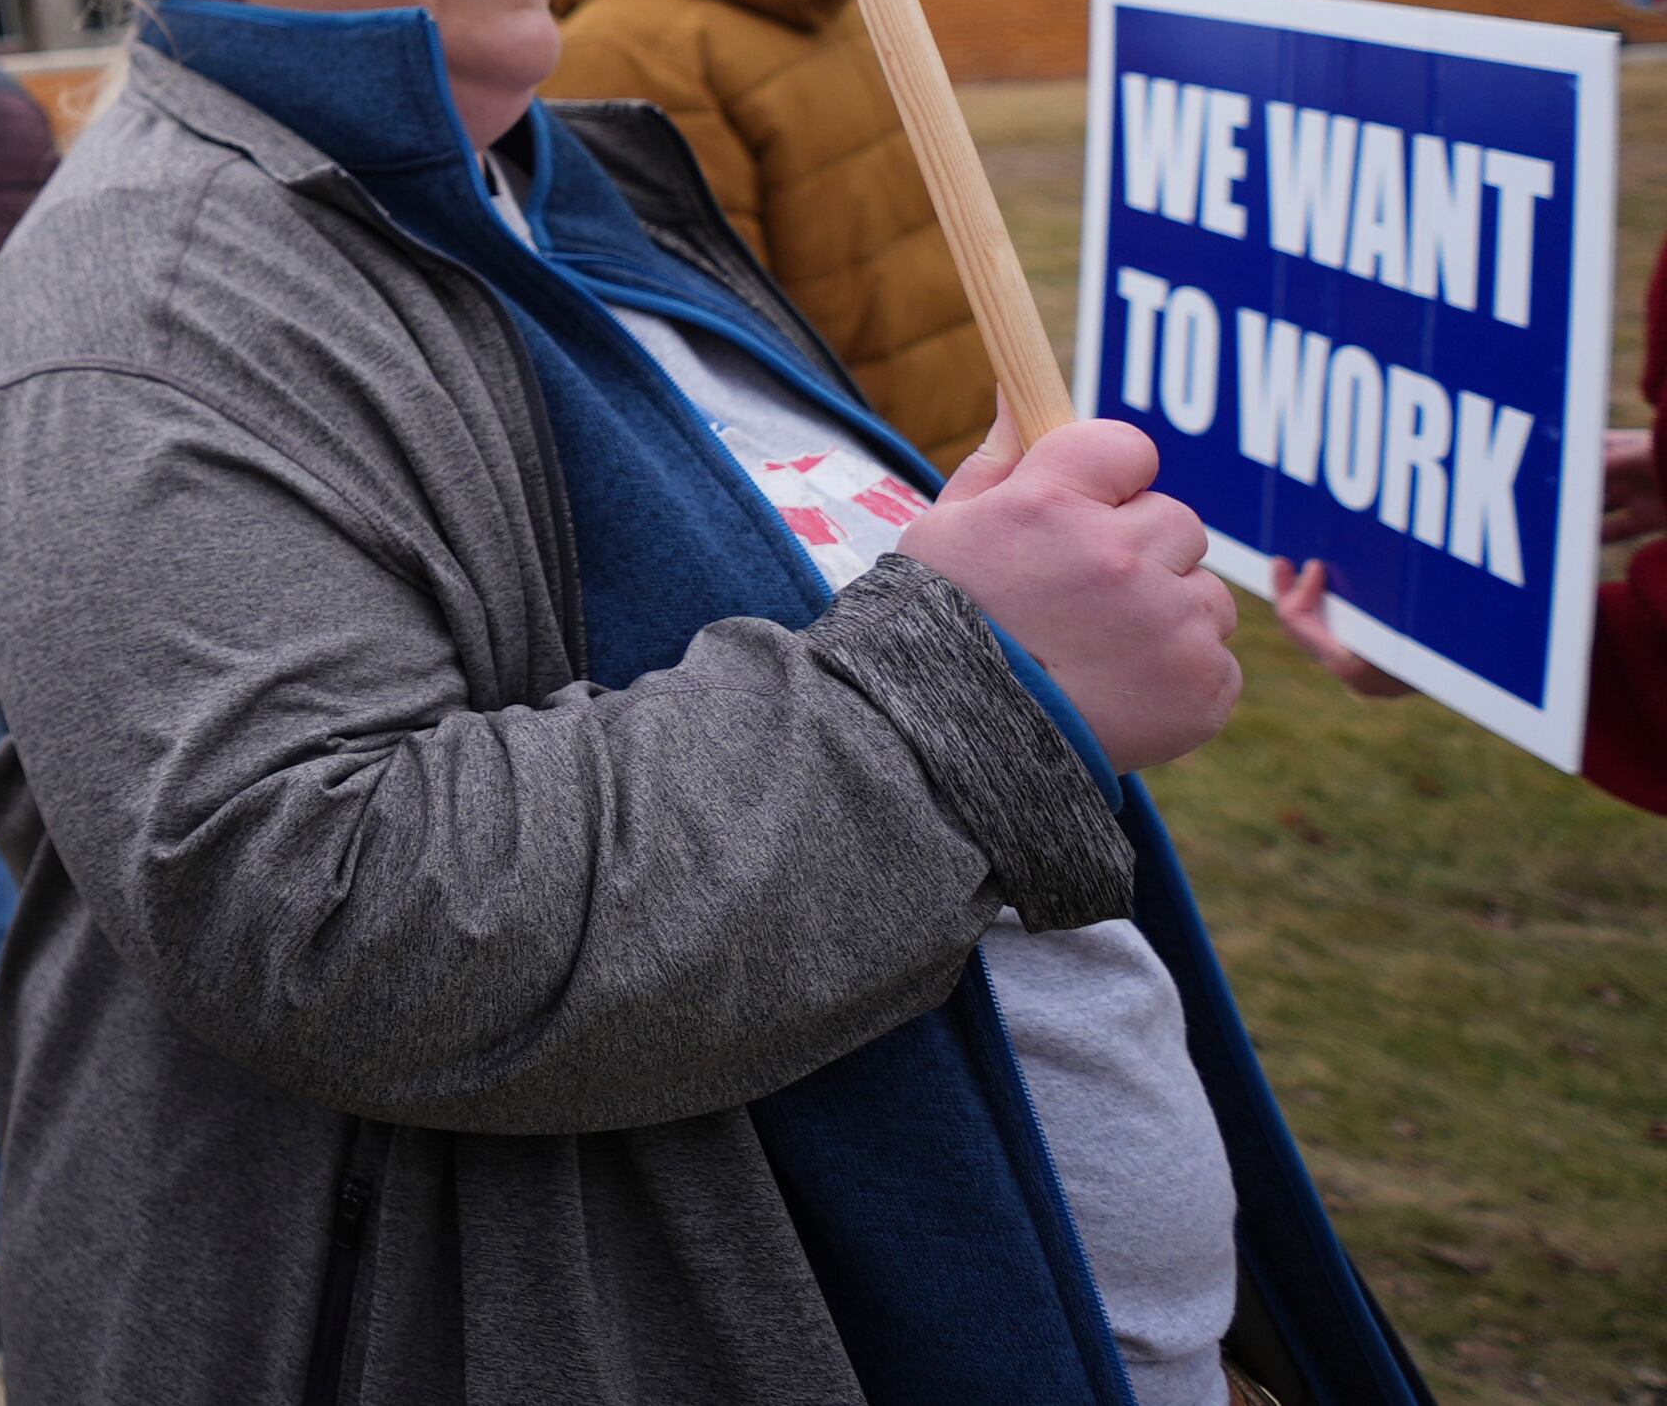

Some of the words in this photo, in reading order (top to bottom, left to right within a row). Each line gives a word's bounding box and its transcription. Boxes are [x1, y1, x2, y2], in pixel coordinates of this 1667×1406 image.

[1121, 72, 1249, 239] WE
[1266, 100, 1554, 328] WANT
[1118, 267, 1221, 435] TO
[1237, 308, 1535, 587] WORK
